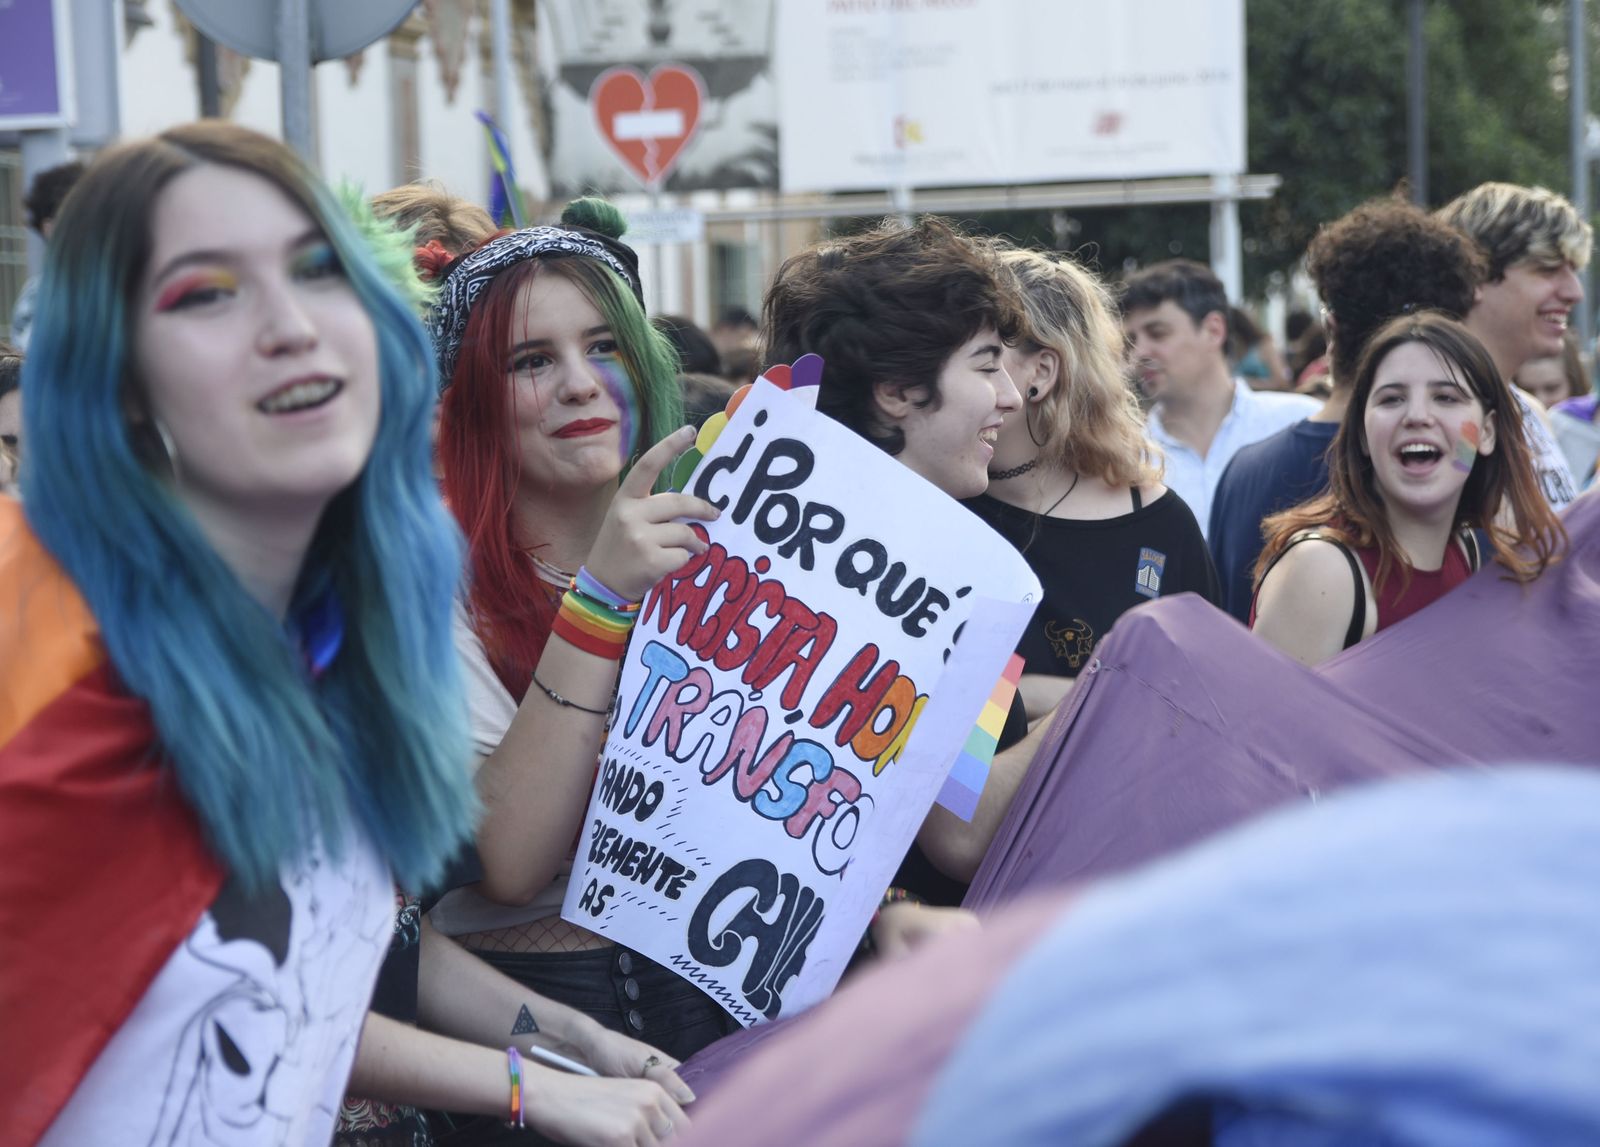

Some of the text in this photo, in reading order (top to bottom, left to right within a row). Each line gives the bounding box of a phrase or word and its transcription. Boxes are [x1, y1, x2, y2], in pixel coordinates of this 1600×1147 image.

[693, 409, 846, 571] ¿POR
[598, 757, 665, 823] ANDO
[624, 639, 875, 881] TRÁNSFO
[578, 867, 616, 918] AS
